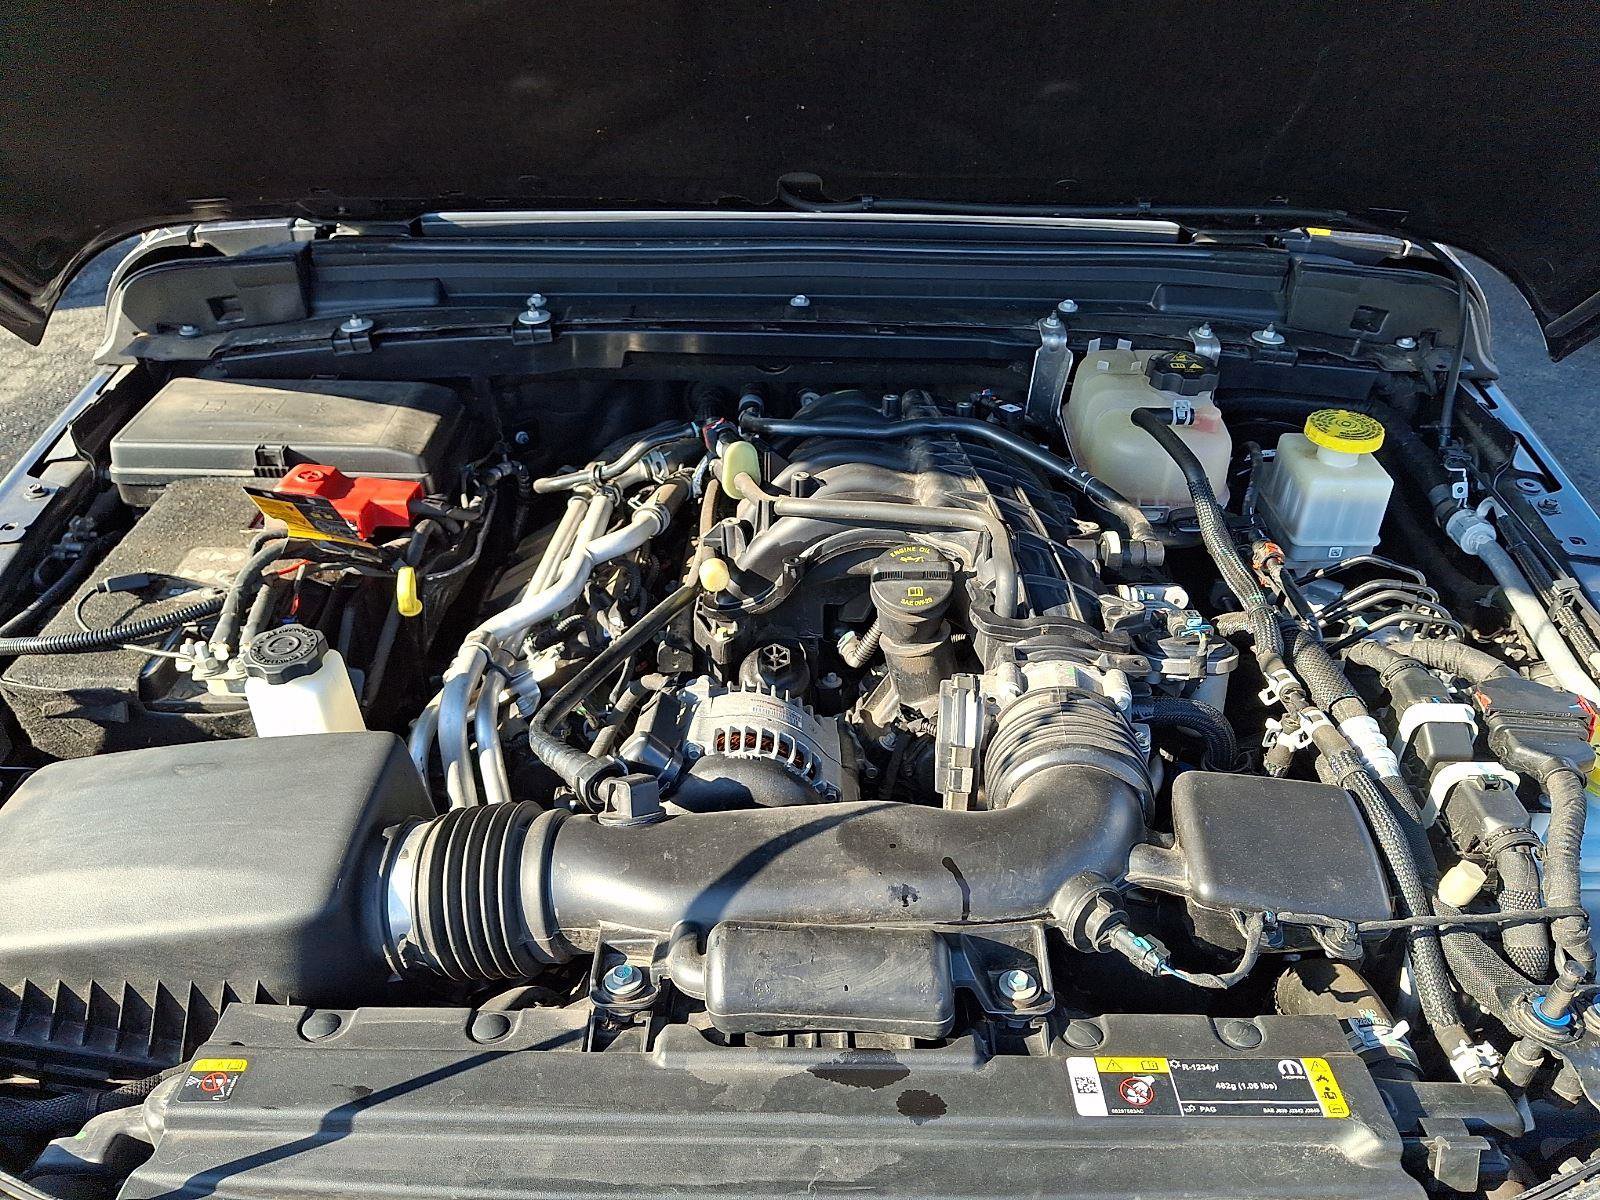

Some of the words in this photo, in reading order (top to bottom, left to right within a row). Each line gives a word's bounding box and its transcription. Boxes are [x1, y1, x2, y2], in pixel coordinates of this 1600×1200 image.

[889, 546, 916, 558] ENGINE
[919, 547, 931, 555] OIL
[1181, 1063, 1220, 1072] R-1234yf
[1260, 1082, 1278, 1091] lbs)
